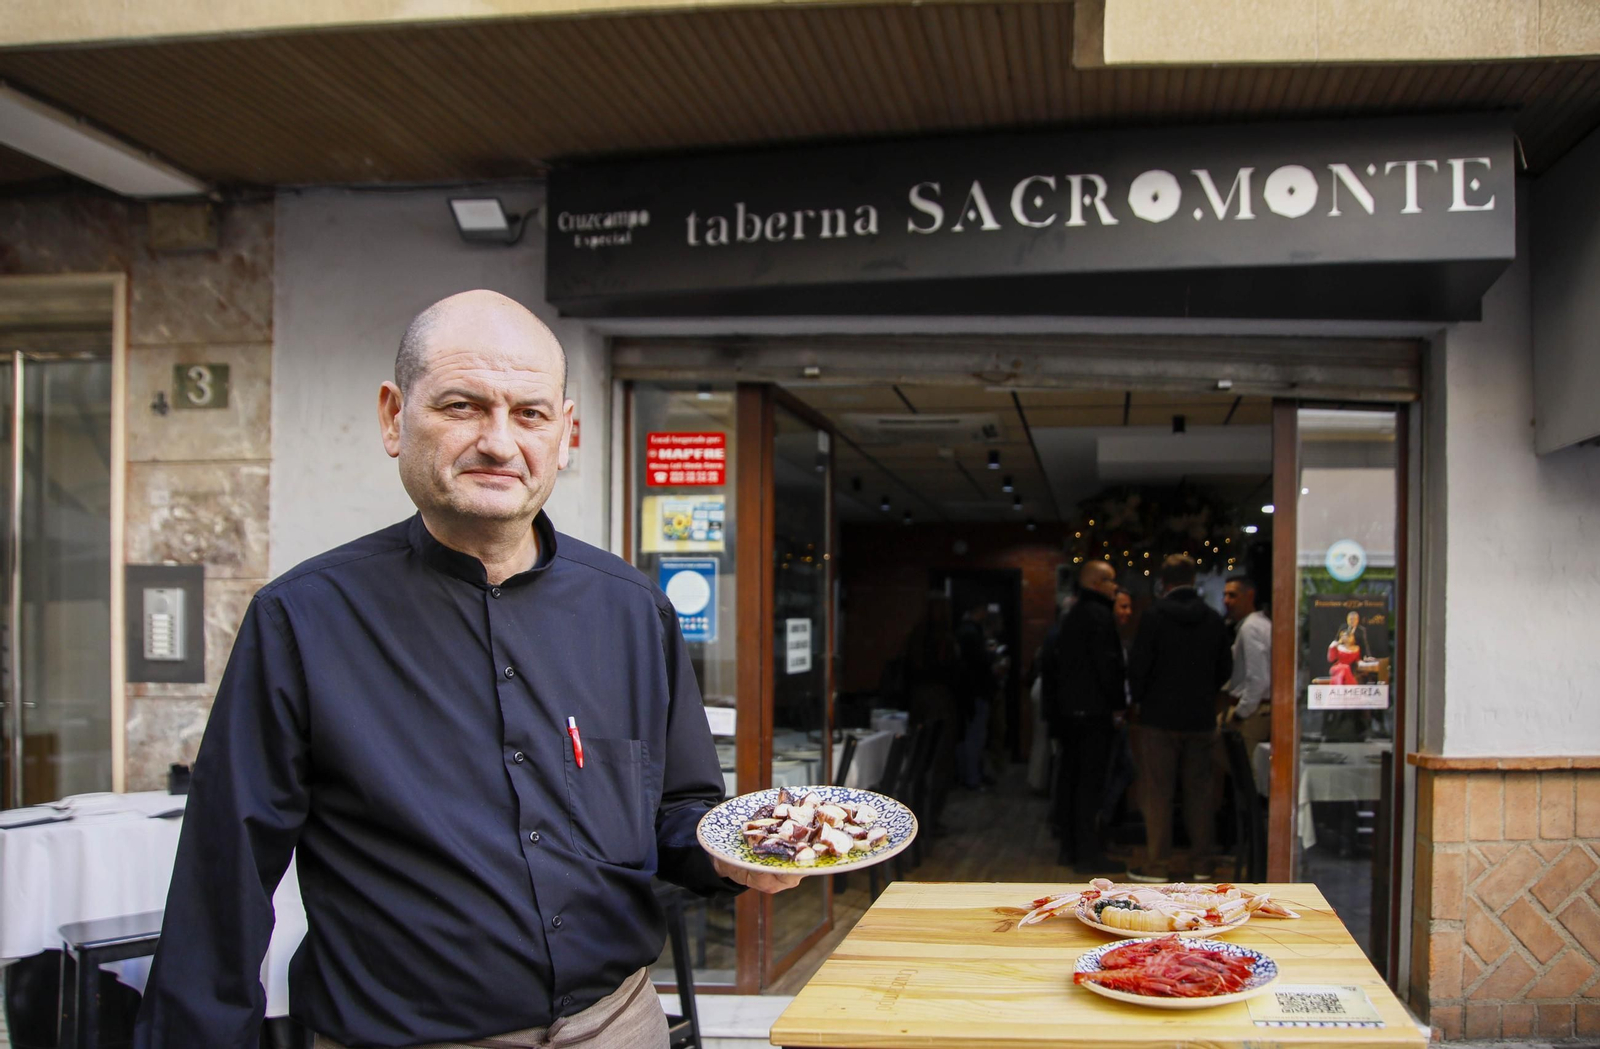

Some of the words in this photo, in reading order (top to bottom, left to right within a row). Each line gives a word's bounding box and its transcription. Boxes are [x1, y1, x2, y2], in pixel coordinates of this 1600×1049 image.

[686, 202, 879, 246] taberna
[907, 157, 1495, 235] SACROMONTE
[557, 209, 649, 232] Cruzcampo
[187, 365, 212, 406] 3
[658, 448, 725, 460] MAPFRE
